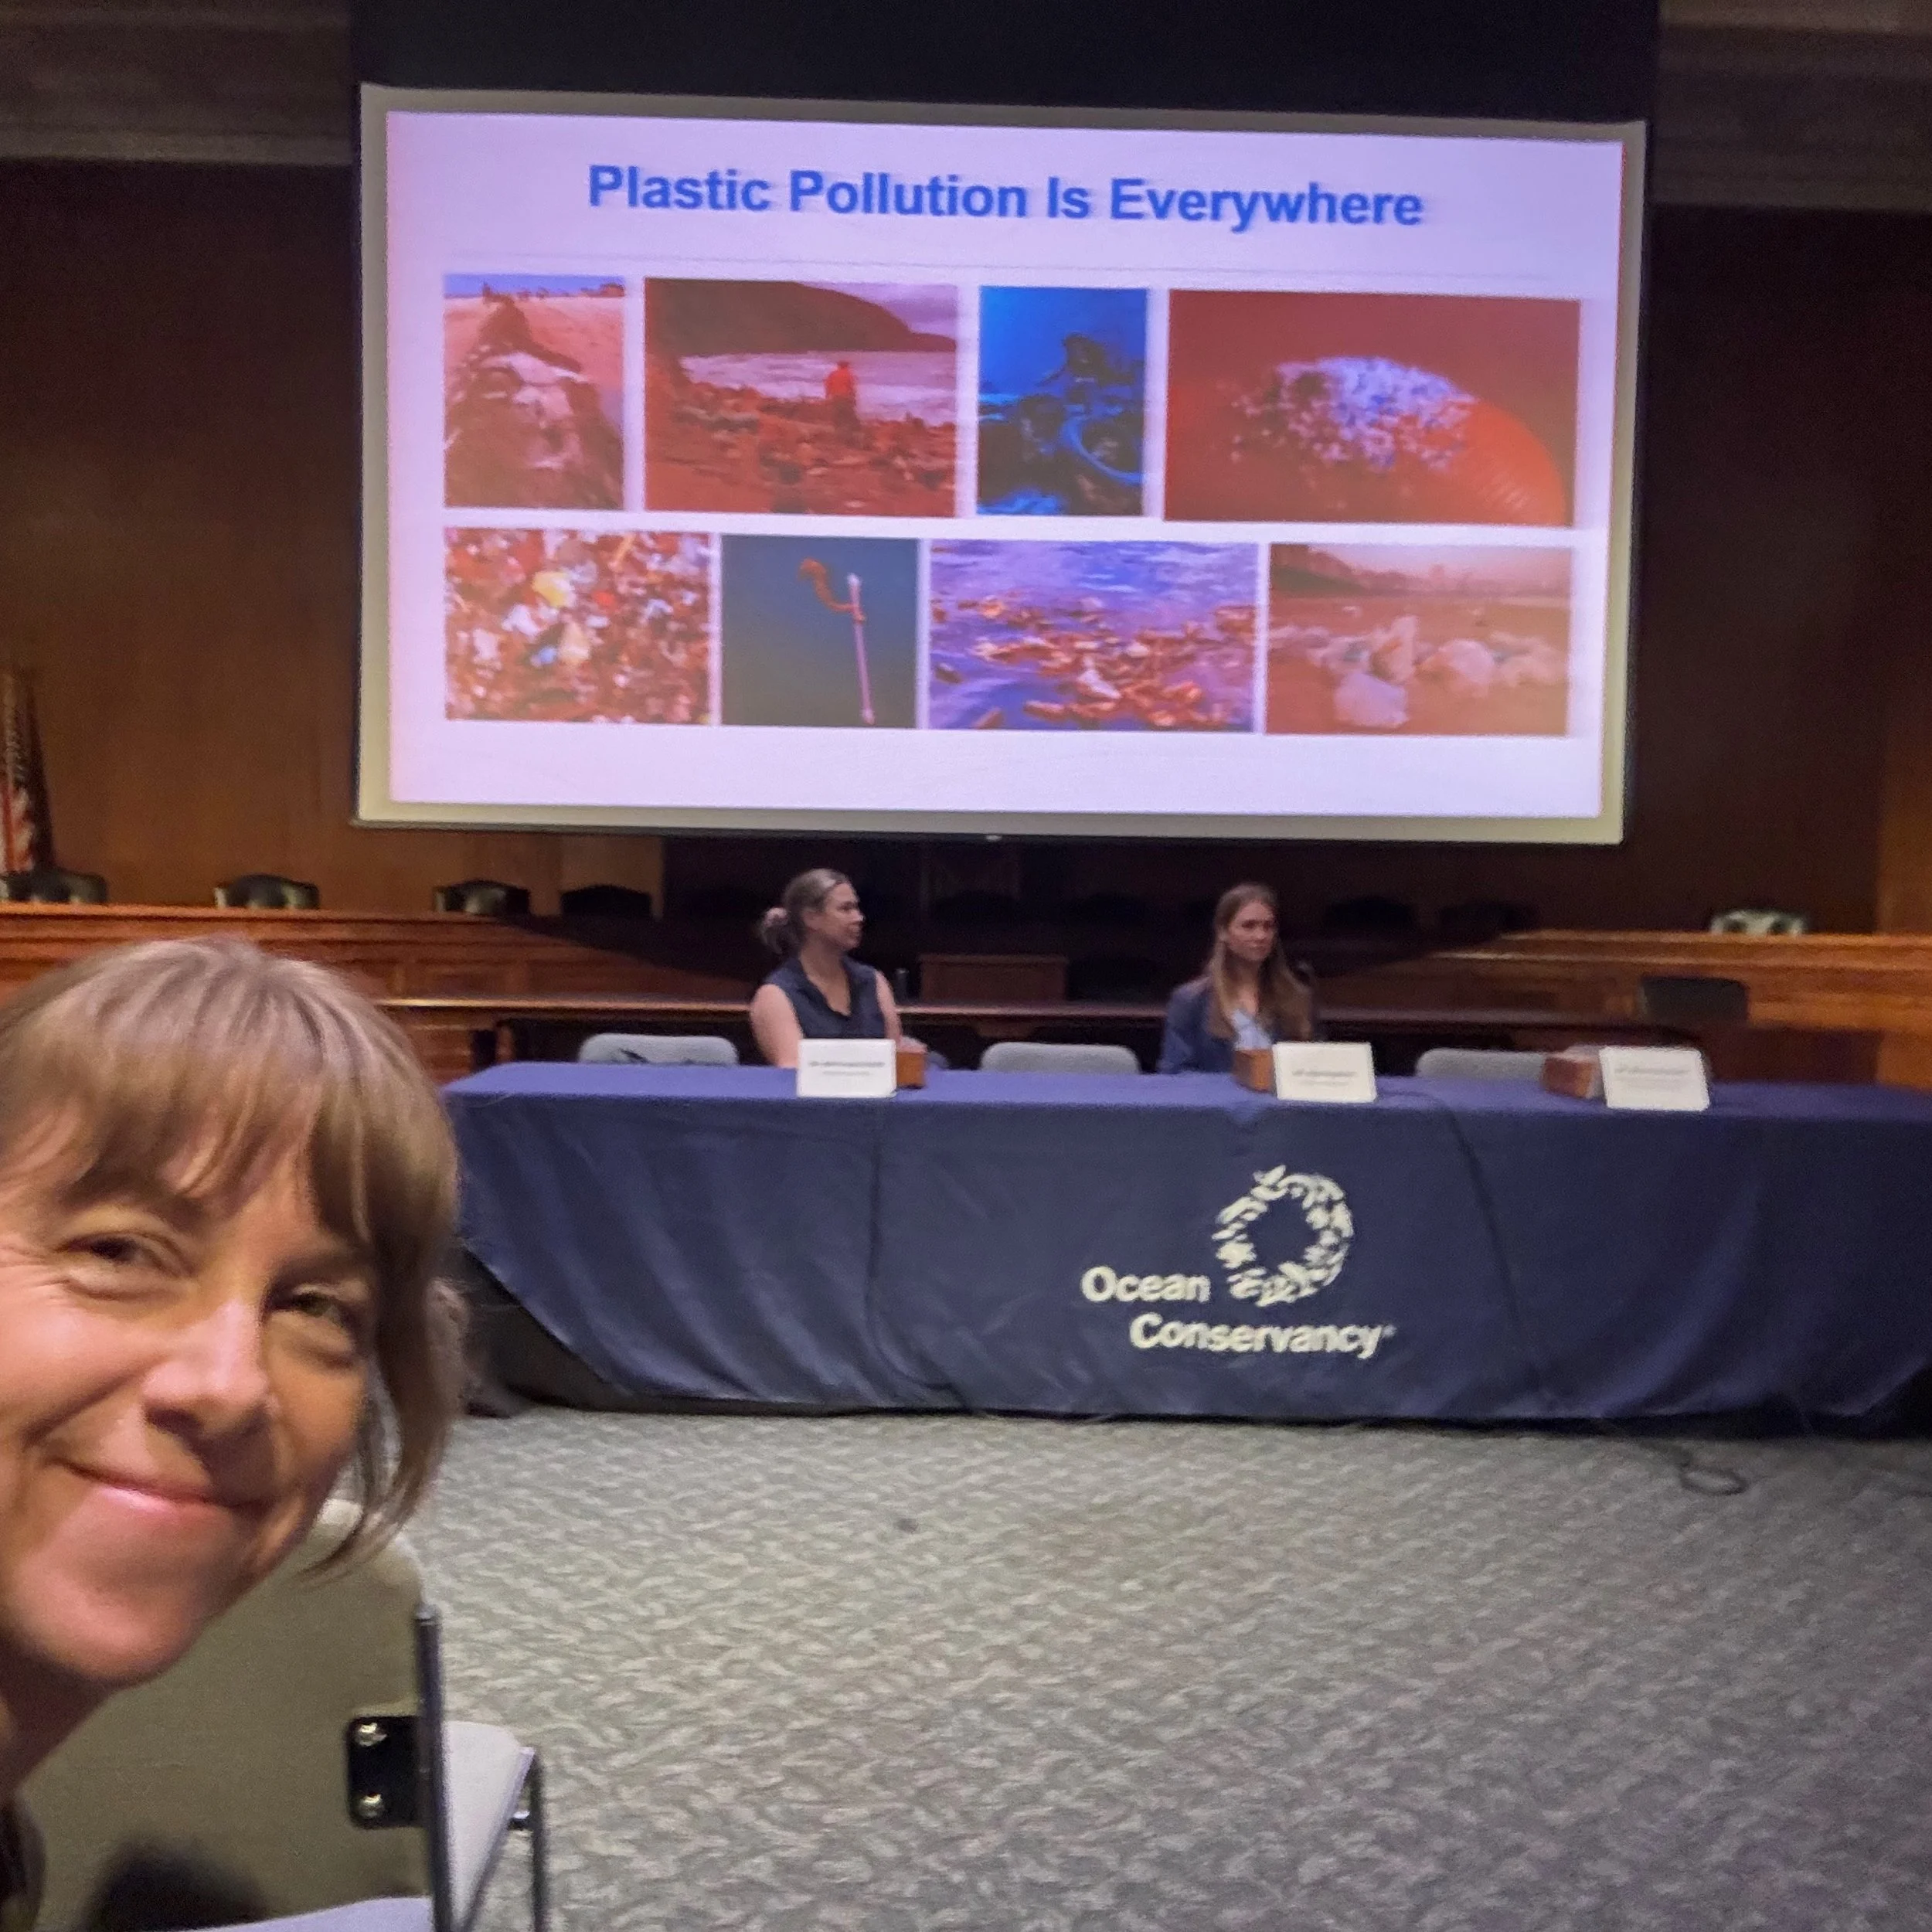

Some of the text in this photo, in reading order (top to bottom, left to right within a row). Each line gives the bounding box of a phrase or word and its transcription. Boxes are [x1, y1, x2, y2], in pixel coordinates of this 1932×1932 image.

[589, 165, 1424, 232] Plastic Pollution Is Everywhere
[1080, 1265, 1211, 1304] Ocean
[1129, 1312, 1383, 1360] Conservancy
